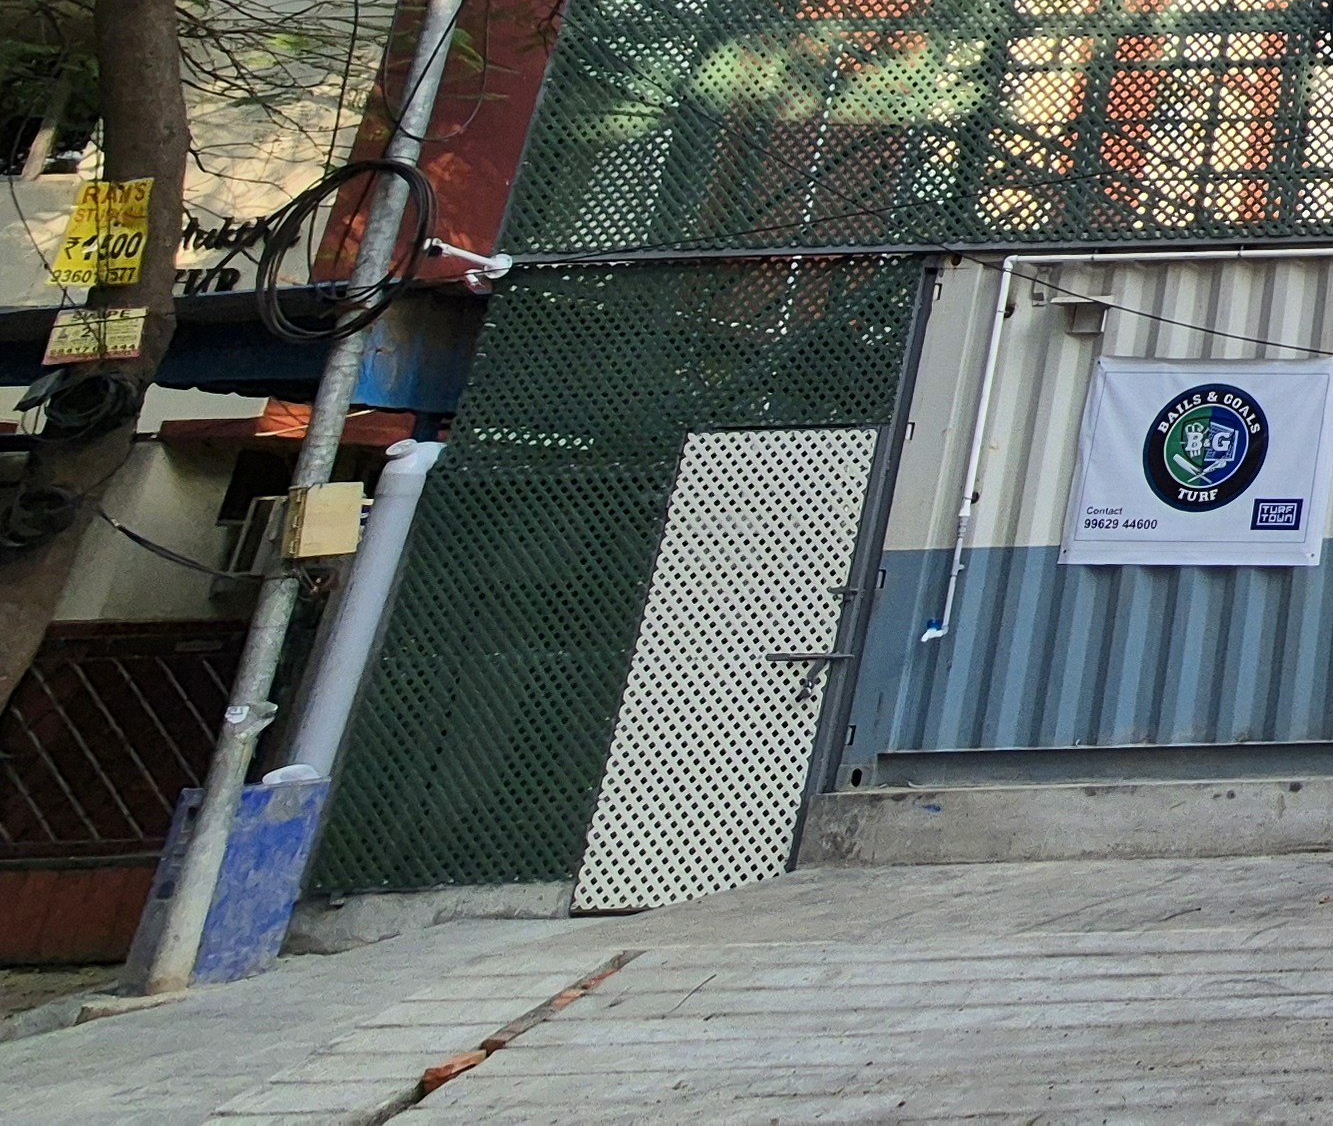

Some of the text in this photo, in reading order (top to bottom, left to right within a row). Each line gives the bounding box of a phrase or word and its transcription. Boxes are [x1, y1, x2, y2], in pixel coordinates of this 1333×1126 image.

[1157, 391, 1261, 434] BAILS & GOALS
[1177, 488, 1219, 503] TURF
[1086, 506, 1123, 515] Contact
[1261, 505, 1294, 514] TURF
[1084, 518, 1158, 530] 99629 44600
